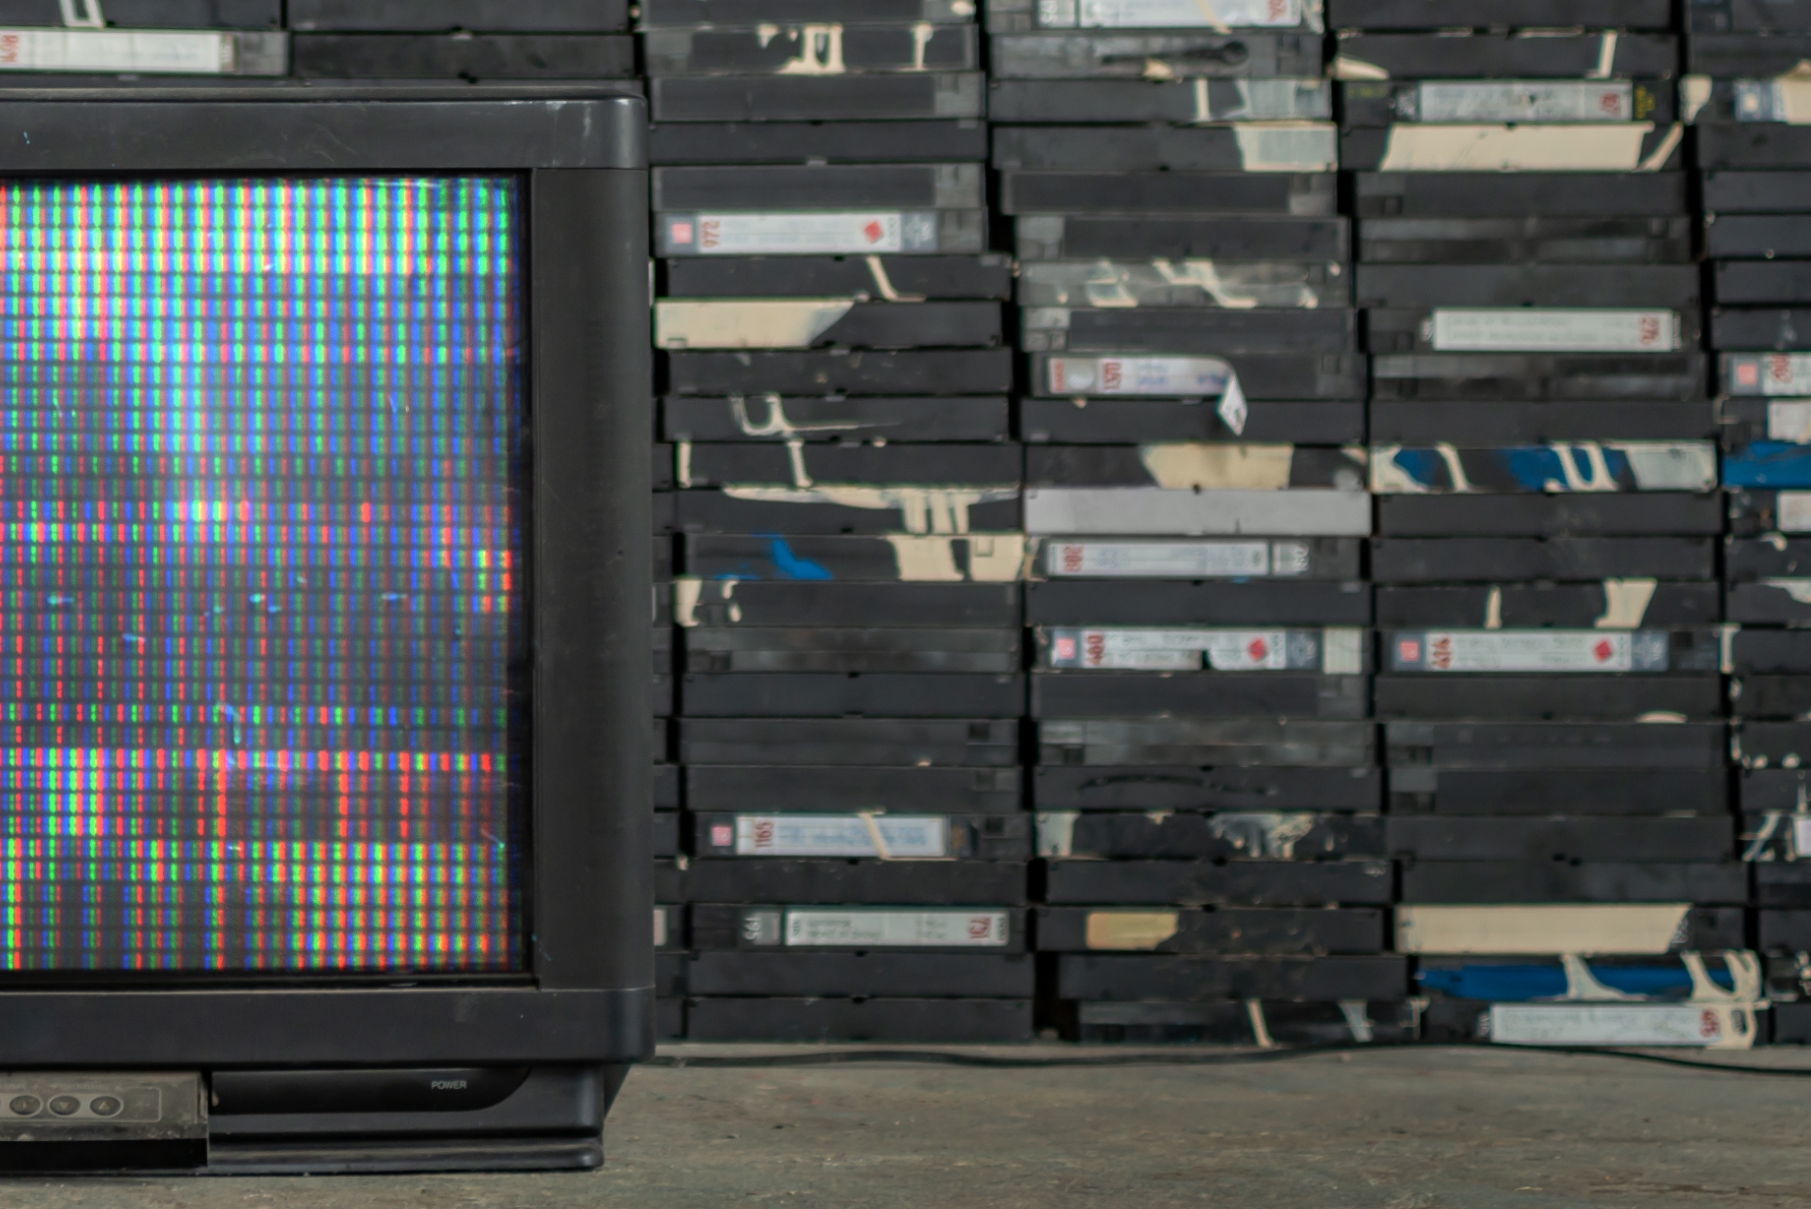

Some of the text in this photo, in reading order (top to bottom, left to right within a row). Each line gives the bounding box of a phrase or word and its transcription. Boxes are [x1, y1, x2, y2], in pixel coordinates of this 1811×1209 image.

[702, 220, 720, 248] 972
[743, 916, 761, 941] 195
[431, 1080, 468, 1090] POWER
